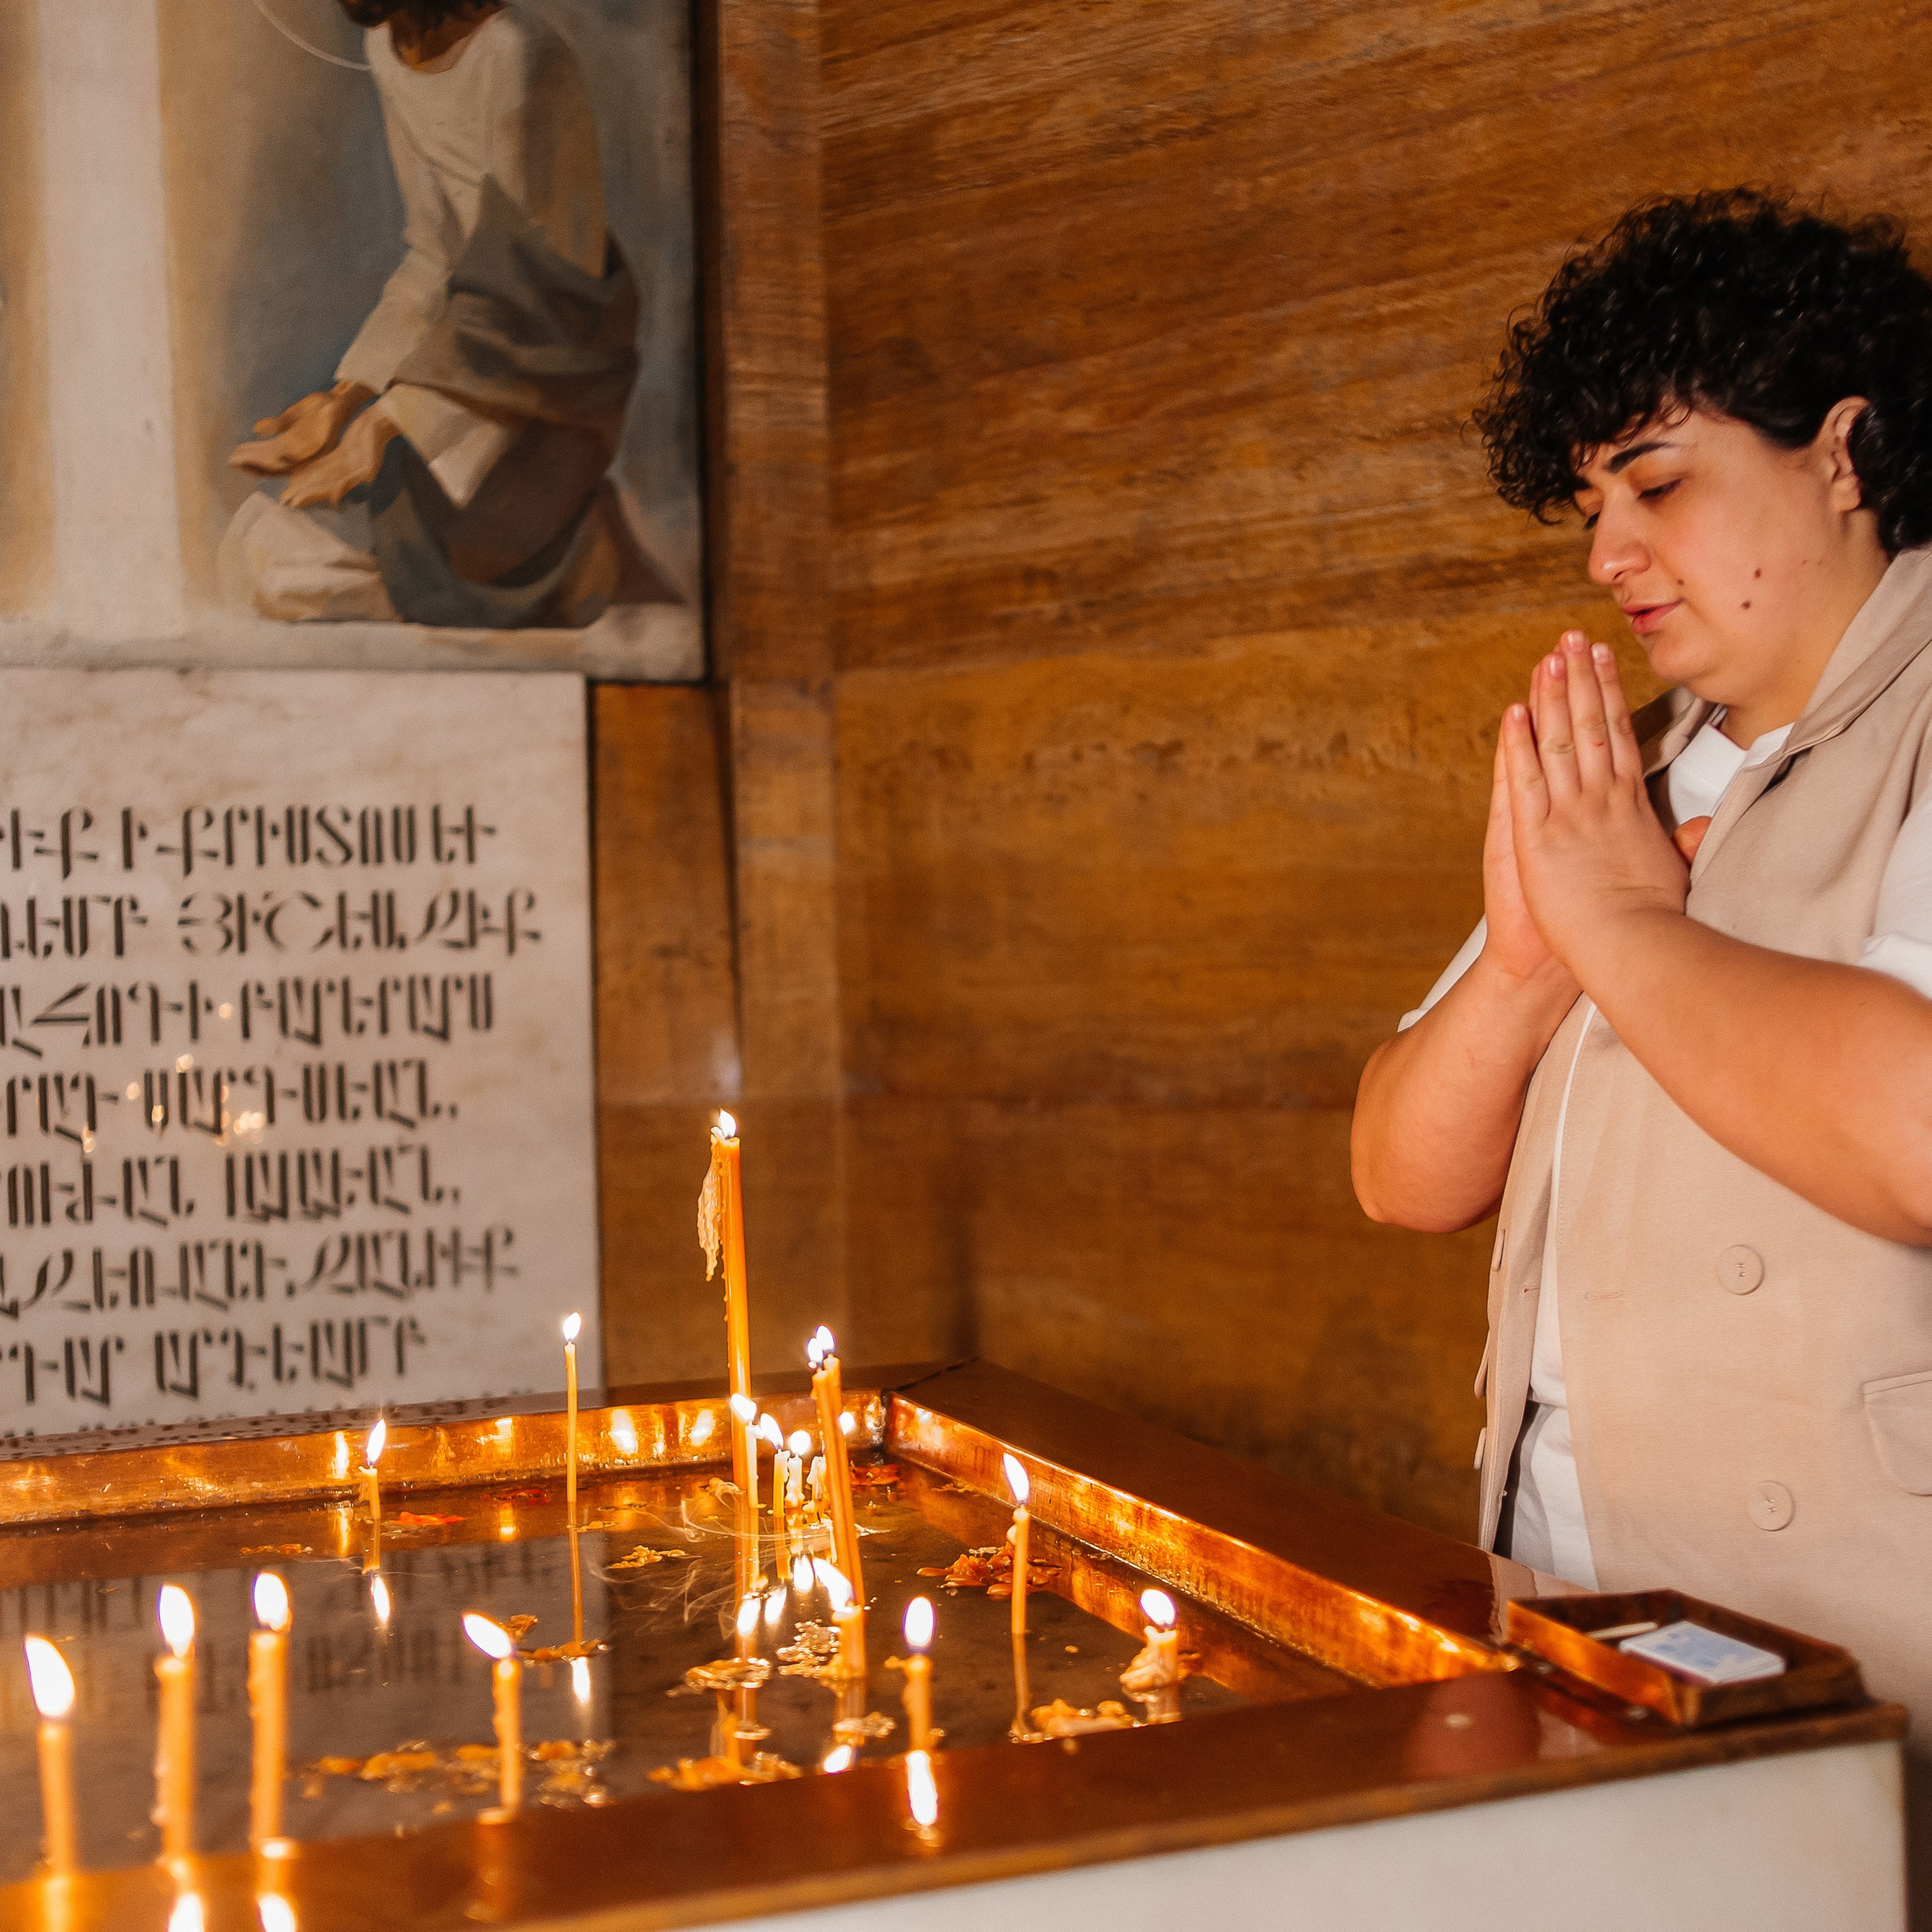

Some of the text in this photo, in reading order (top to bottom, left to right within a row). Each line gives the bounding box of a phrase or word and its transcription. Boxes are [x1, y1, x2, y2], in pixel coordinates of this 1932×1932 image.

[0, 808, 98, 880] ՒՔ
[155, 804, 415, 877] ՔՐԻՍՏՈՍ
[0, 1239, 287, 1321] ՋԵՌԱՆԴ
[0, 1336, 125, 1408] ԴԱՐ
